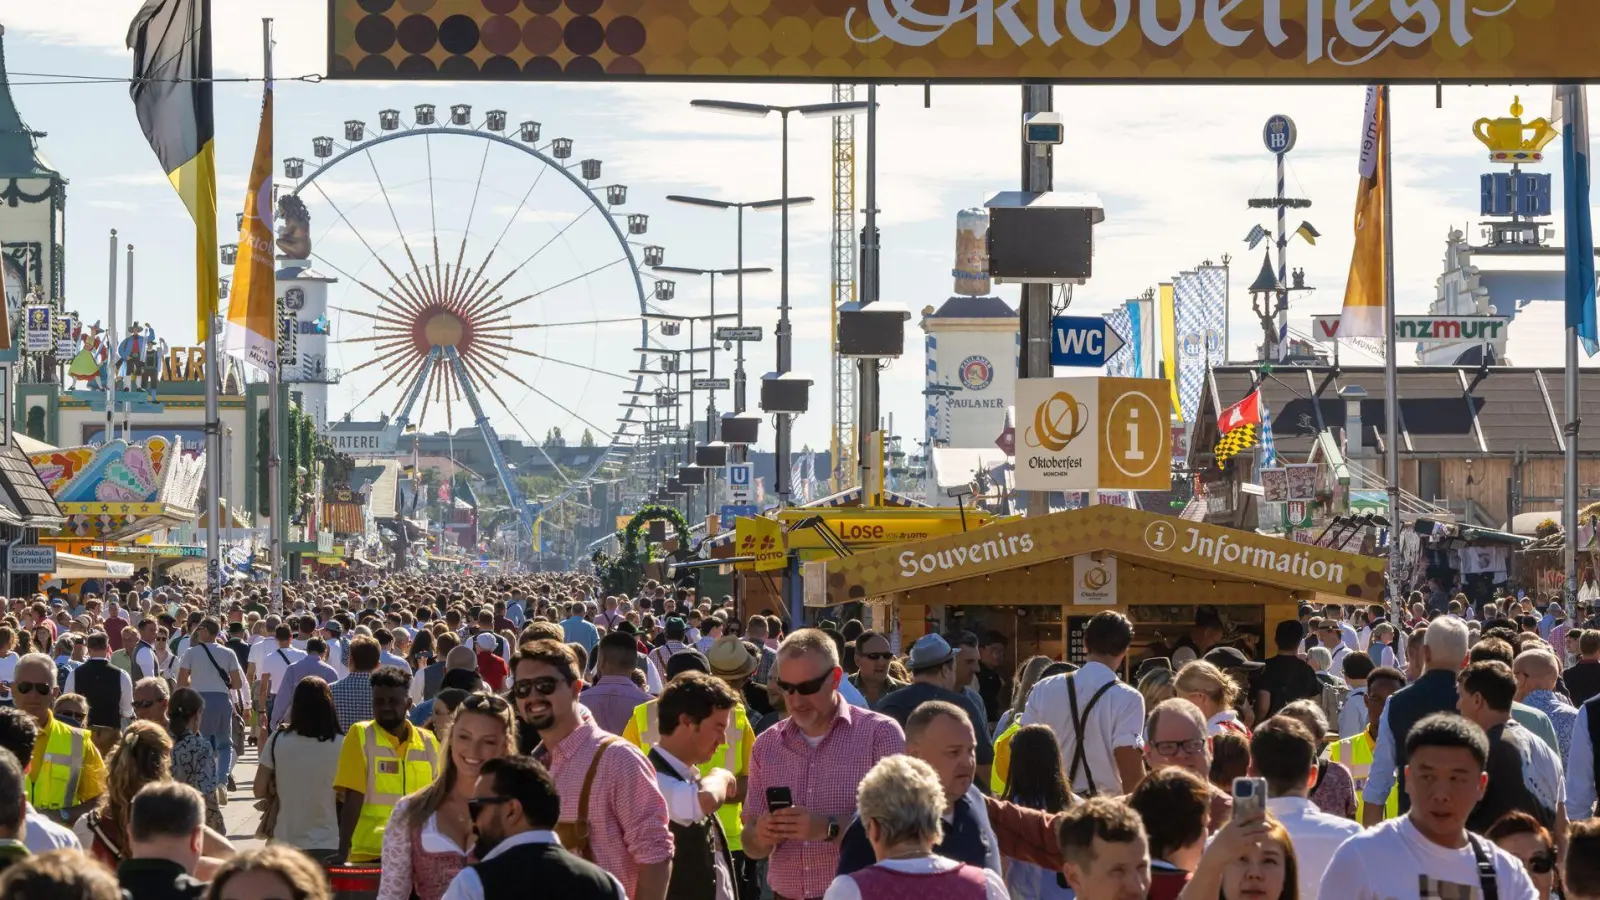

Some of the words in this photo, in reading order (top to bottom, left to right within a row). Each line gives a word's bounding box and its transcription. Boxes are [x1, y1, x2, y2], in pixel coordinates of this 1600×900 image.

[1058, 327, 1103, 355] WC
[949, 398, 1004, 409] PAULANER
[1028, 455, 1083, 470] Oktoberfest
[733, 467, 747, 484] U
[840, 520, 884, 540] Lose
[11, 556, 52, 565] Garnelen
[12, 549, 52, 557] Knoblauch
[756, 551, 784, 562] LOTTO
[899, 531, 1035, 579] Souvenirs
[1181, 527, 1344, 584] Information
